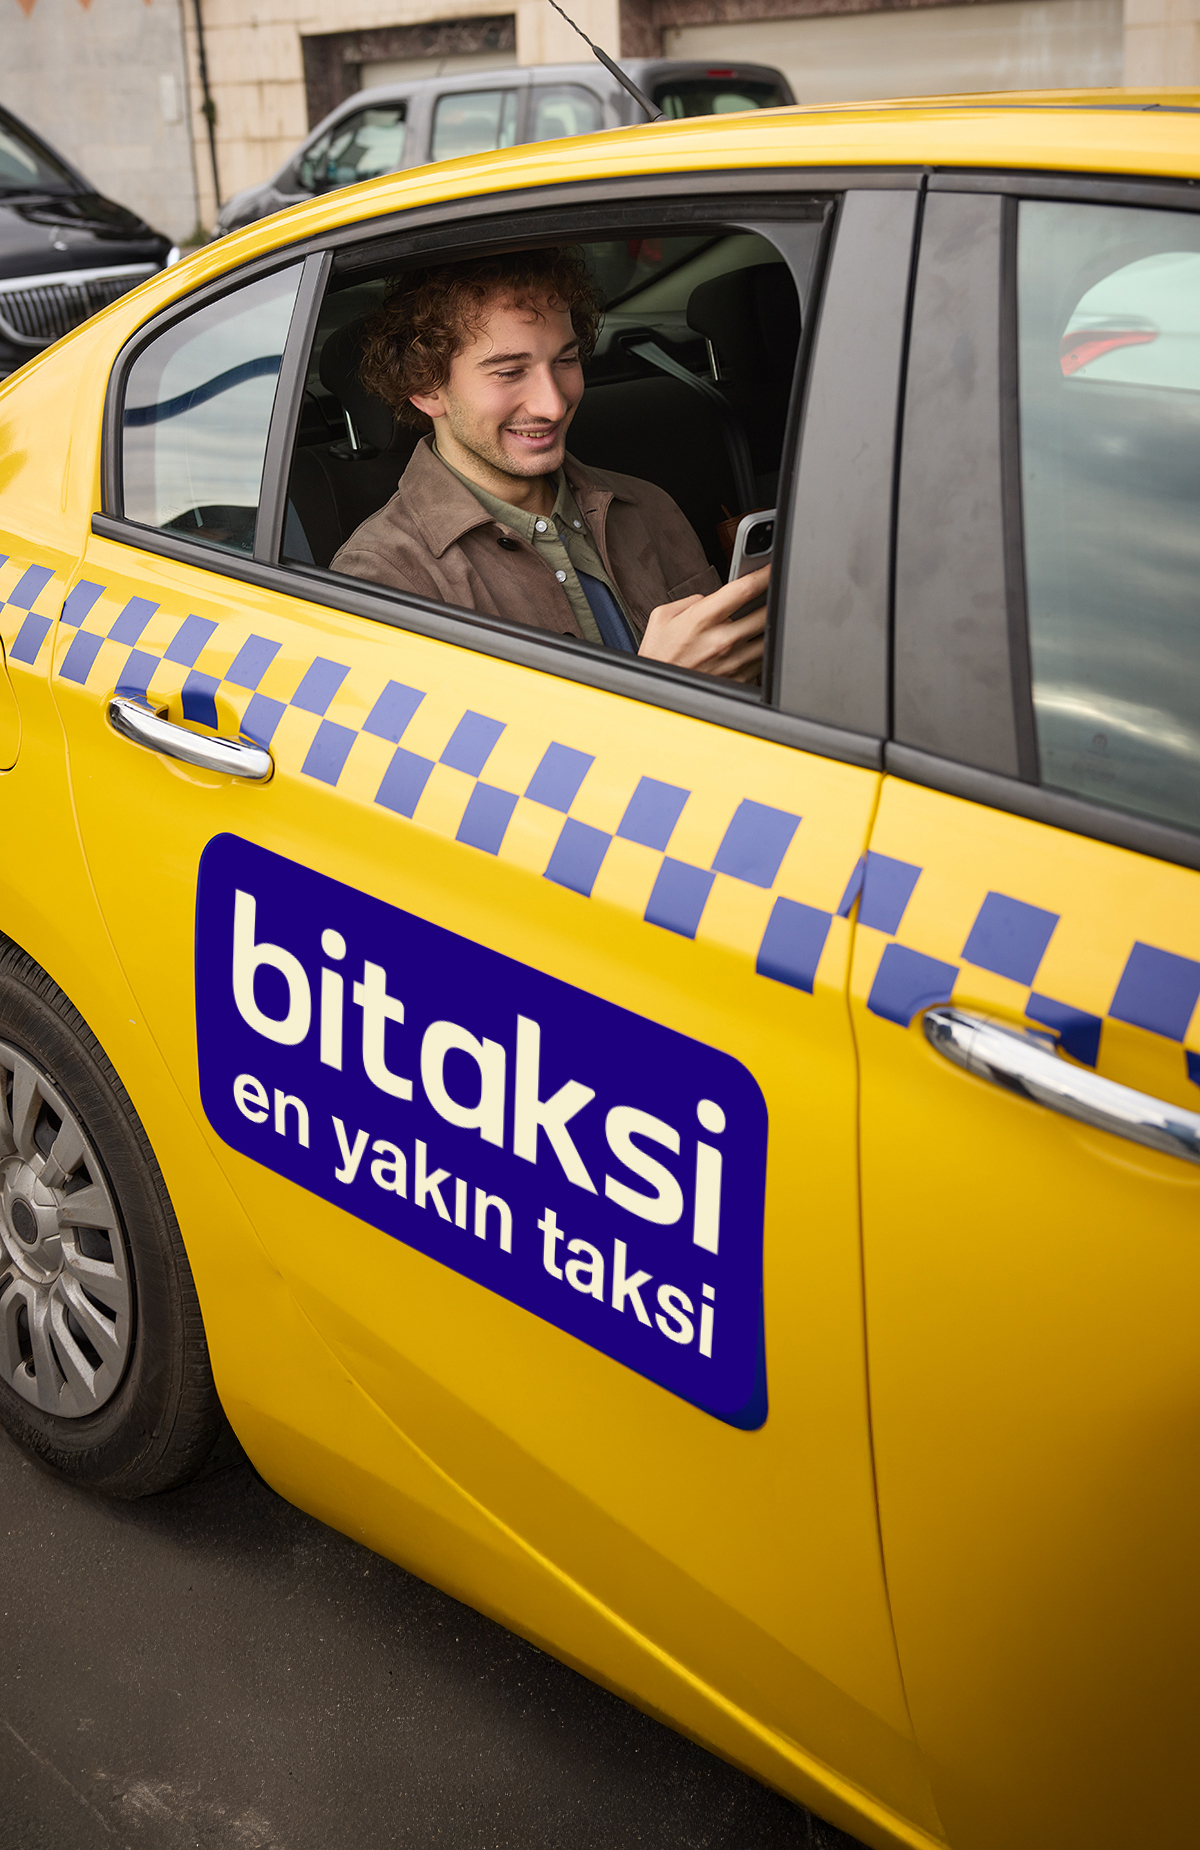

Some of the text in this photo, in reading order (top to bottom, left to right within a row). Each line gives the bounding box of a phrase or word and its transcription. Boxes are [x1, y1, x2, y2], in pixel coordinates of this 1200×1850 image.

[231, 888, 727, 1256] bitaksi
[233, 1073, 716, 1360] en yakın taksi
